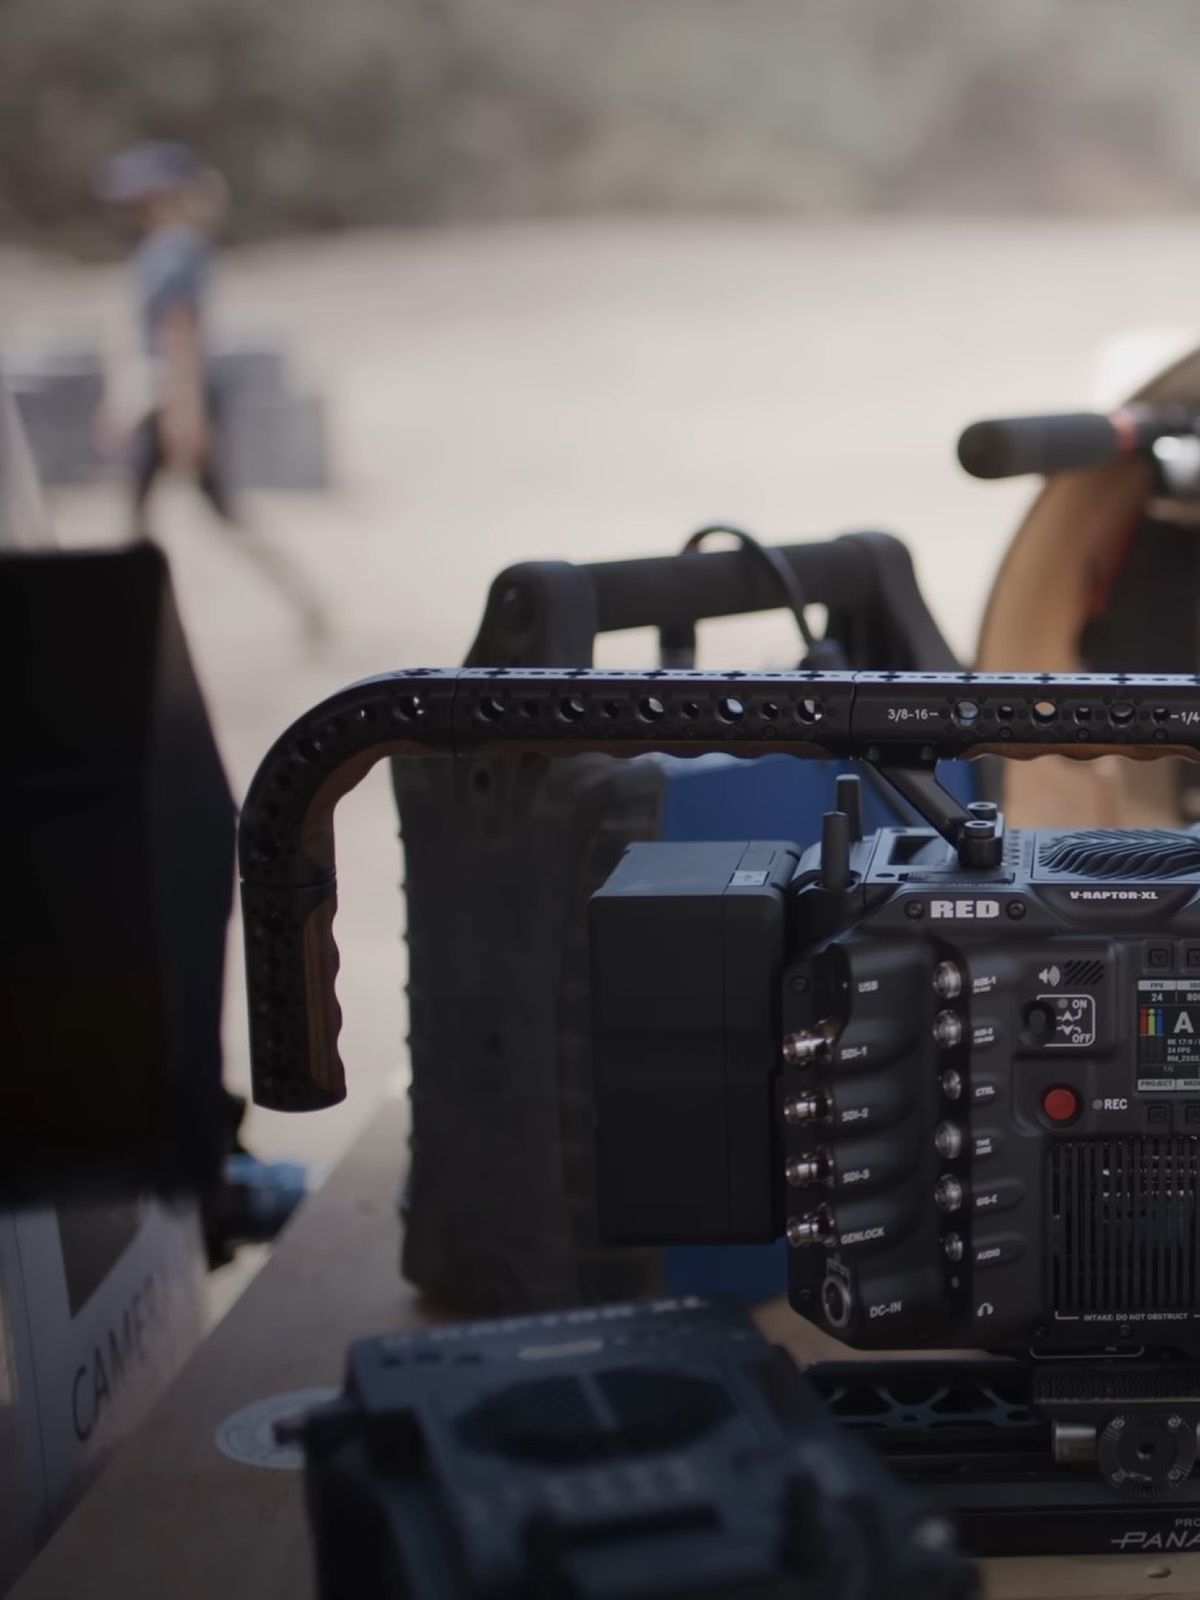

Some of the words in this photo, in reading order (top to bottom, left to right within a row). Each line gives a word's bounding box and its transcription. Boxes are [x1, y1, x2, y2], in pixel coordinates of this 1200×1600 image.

[1070, 891, 1159, 900] V-RAPTOR-XL
[930, 900, 1000, 919] RED
[858, 980, 879, 993] USB
[1151, 993, 1164, 1002] 24
[1072, 999, 1089, 1009] ON
[1173, 1011, 1195, 1034] A
[1072, 1034, 1092, 1044] OFF
[1104, 1099, 1128, 1110] REC
[840, 1227, 885, 1245] GENLOCK
[869, 1301, 902, 1318] DC-IN
[1115, 1312, 1128, 1321] DO
[1129, 1312, 1146, 1321] NOT
[1147, 1311, 1188, 1321] OBSTRUCT
